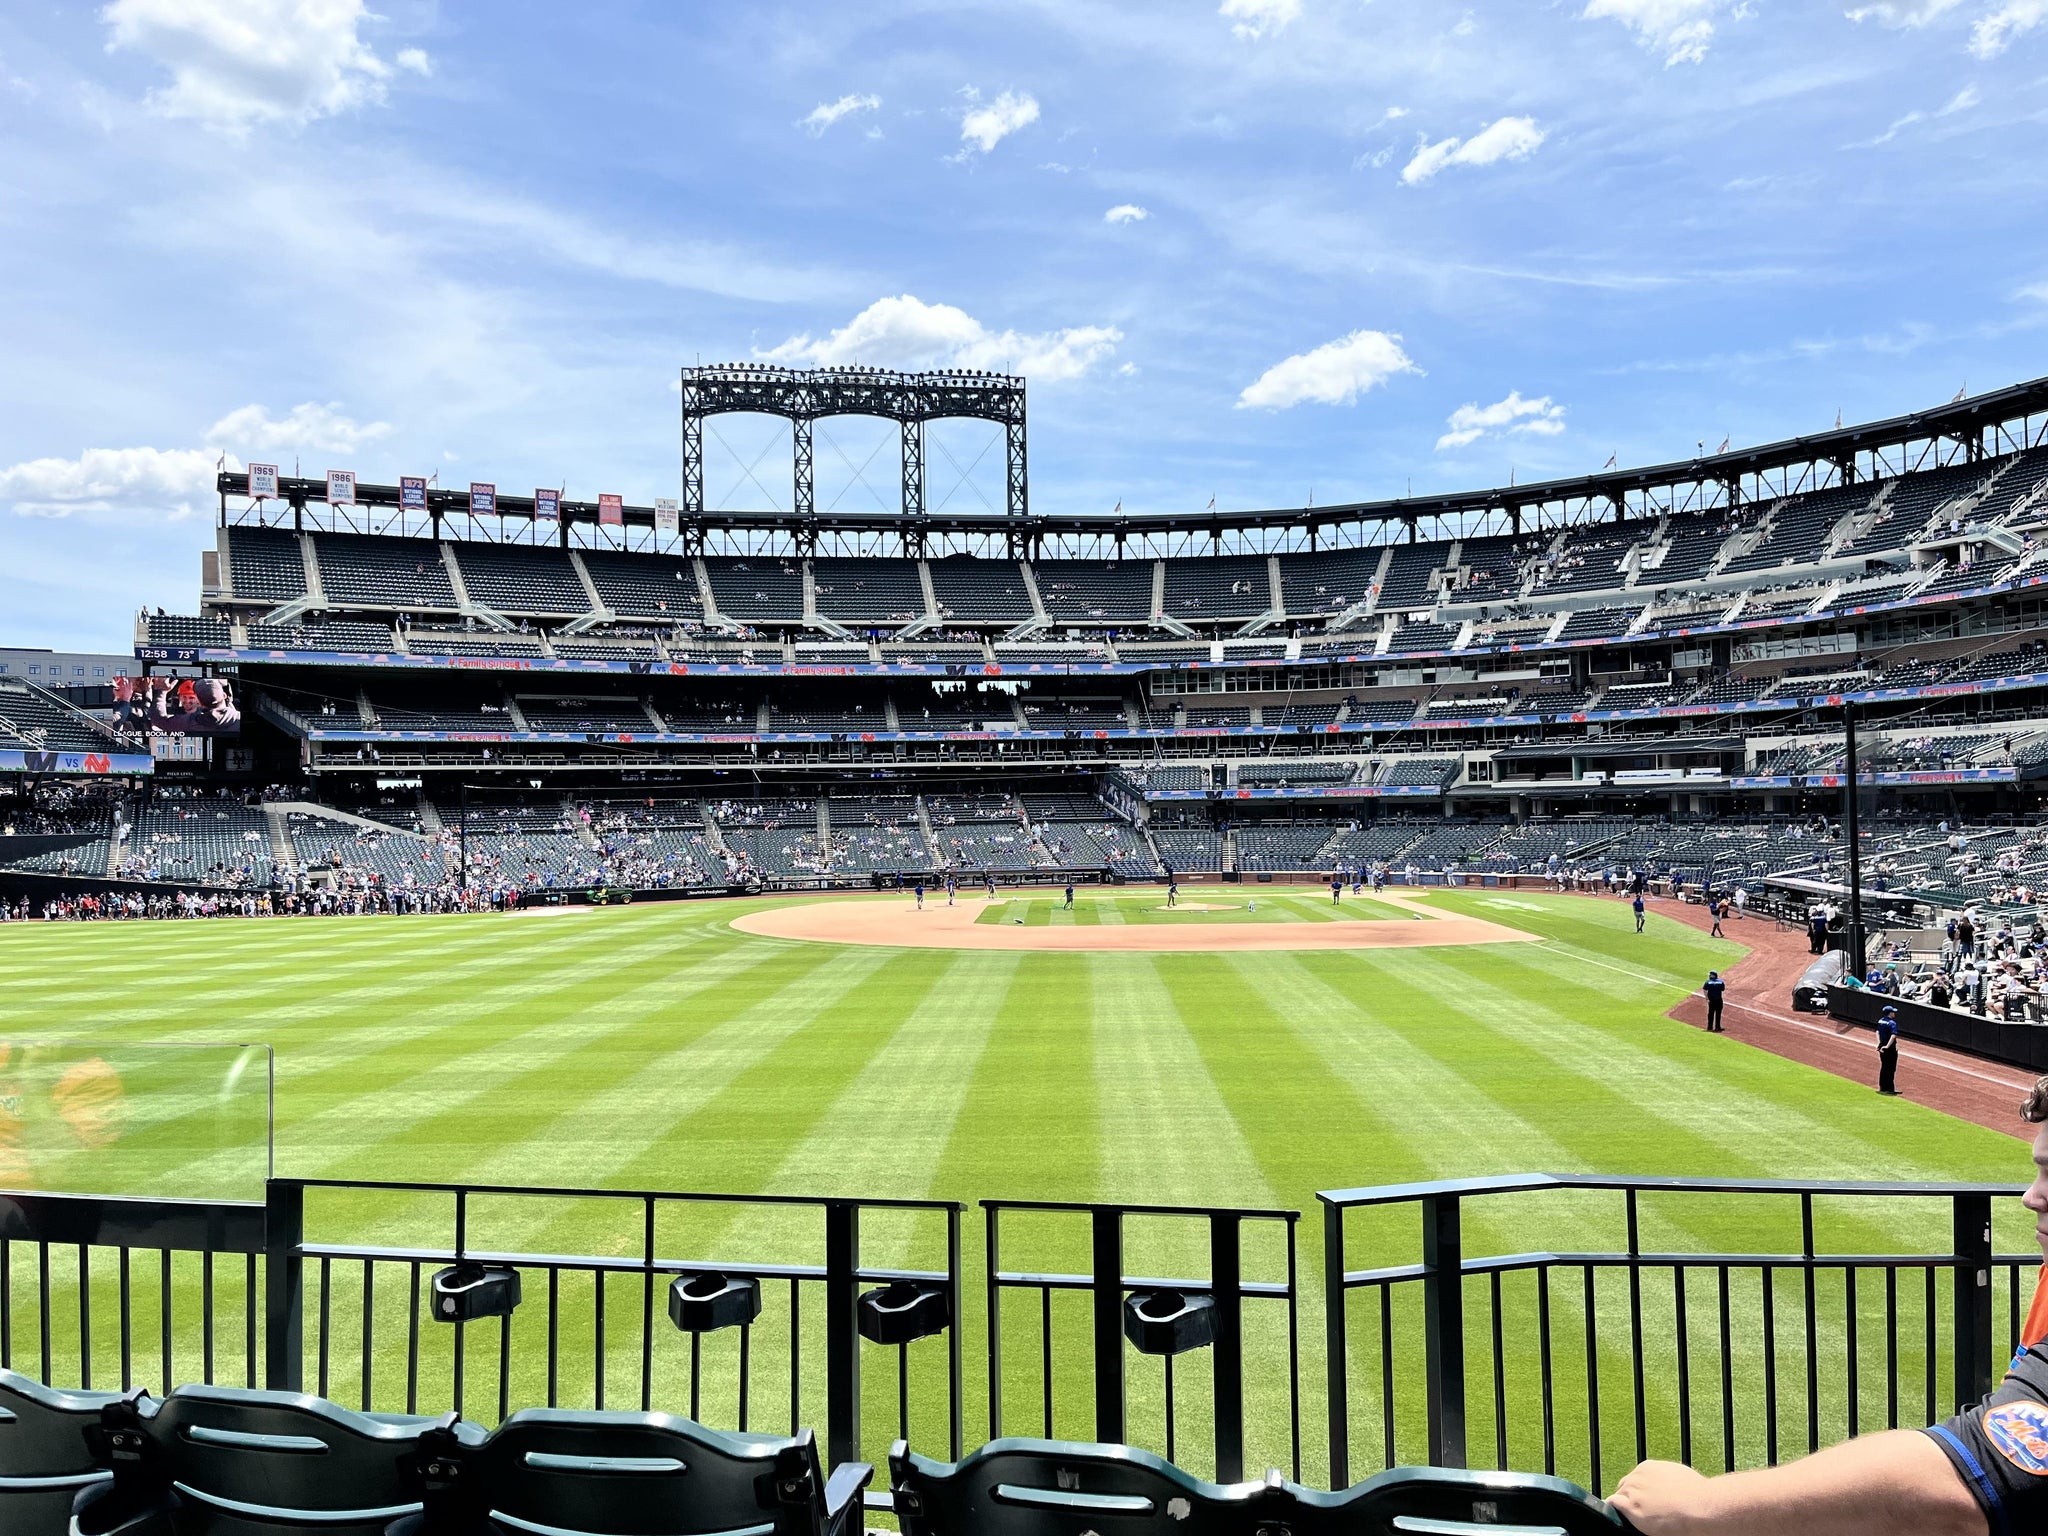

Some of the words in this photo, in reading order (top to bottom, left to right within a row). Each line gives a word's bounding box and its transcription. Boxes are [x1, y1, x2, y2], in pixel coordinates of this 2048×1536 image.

[254, 467, 274, 476] 1969
[331, 473, 351, 482] 1986
[472, 485, 493, 494] 2000
[141, 650, 167, 659] 12:58
[458, 658, 486, 669] Family
[791, 666, 816, 674] Family
[65, 758, 79, 768] VS
